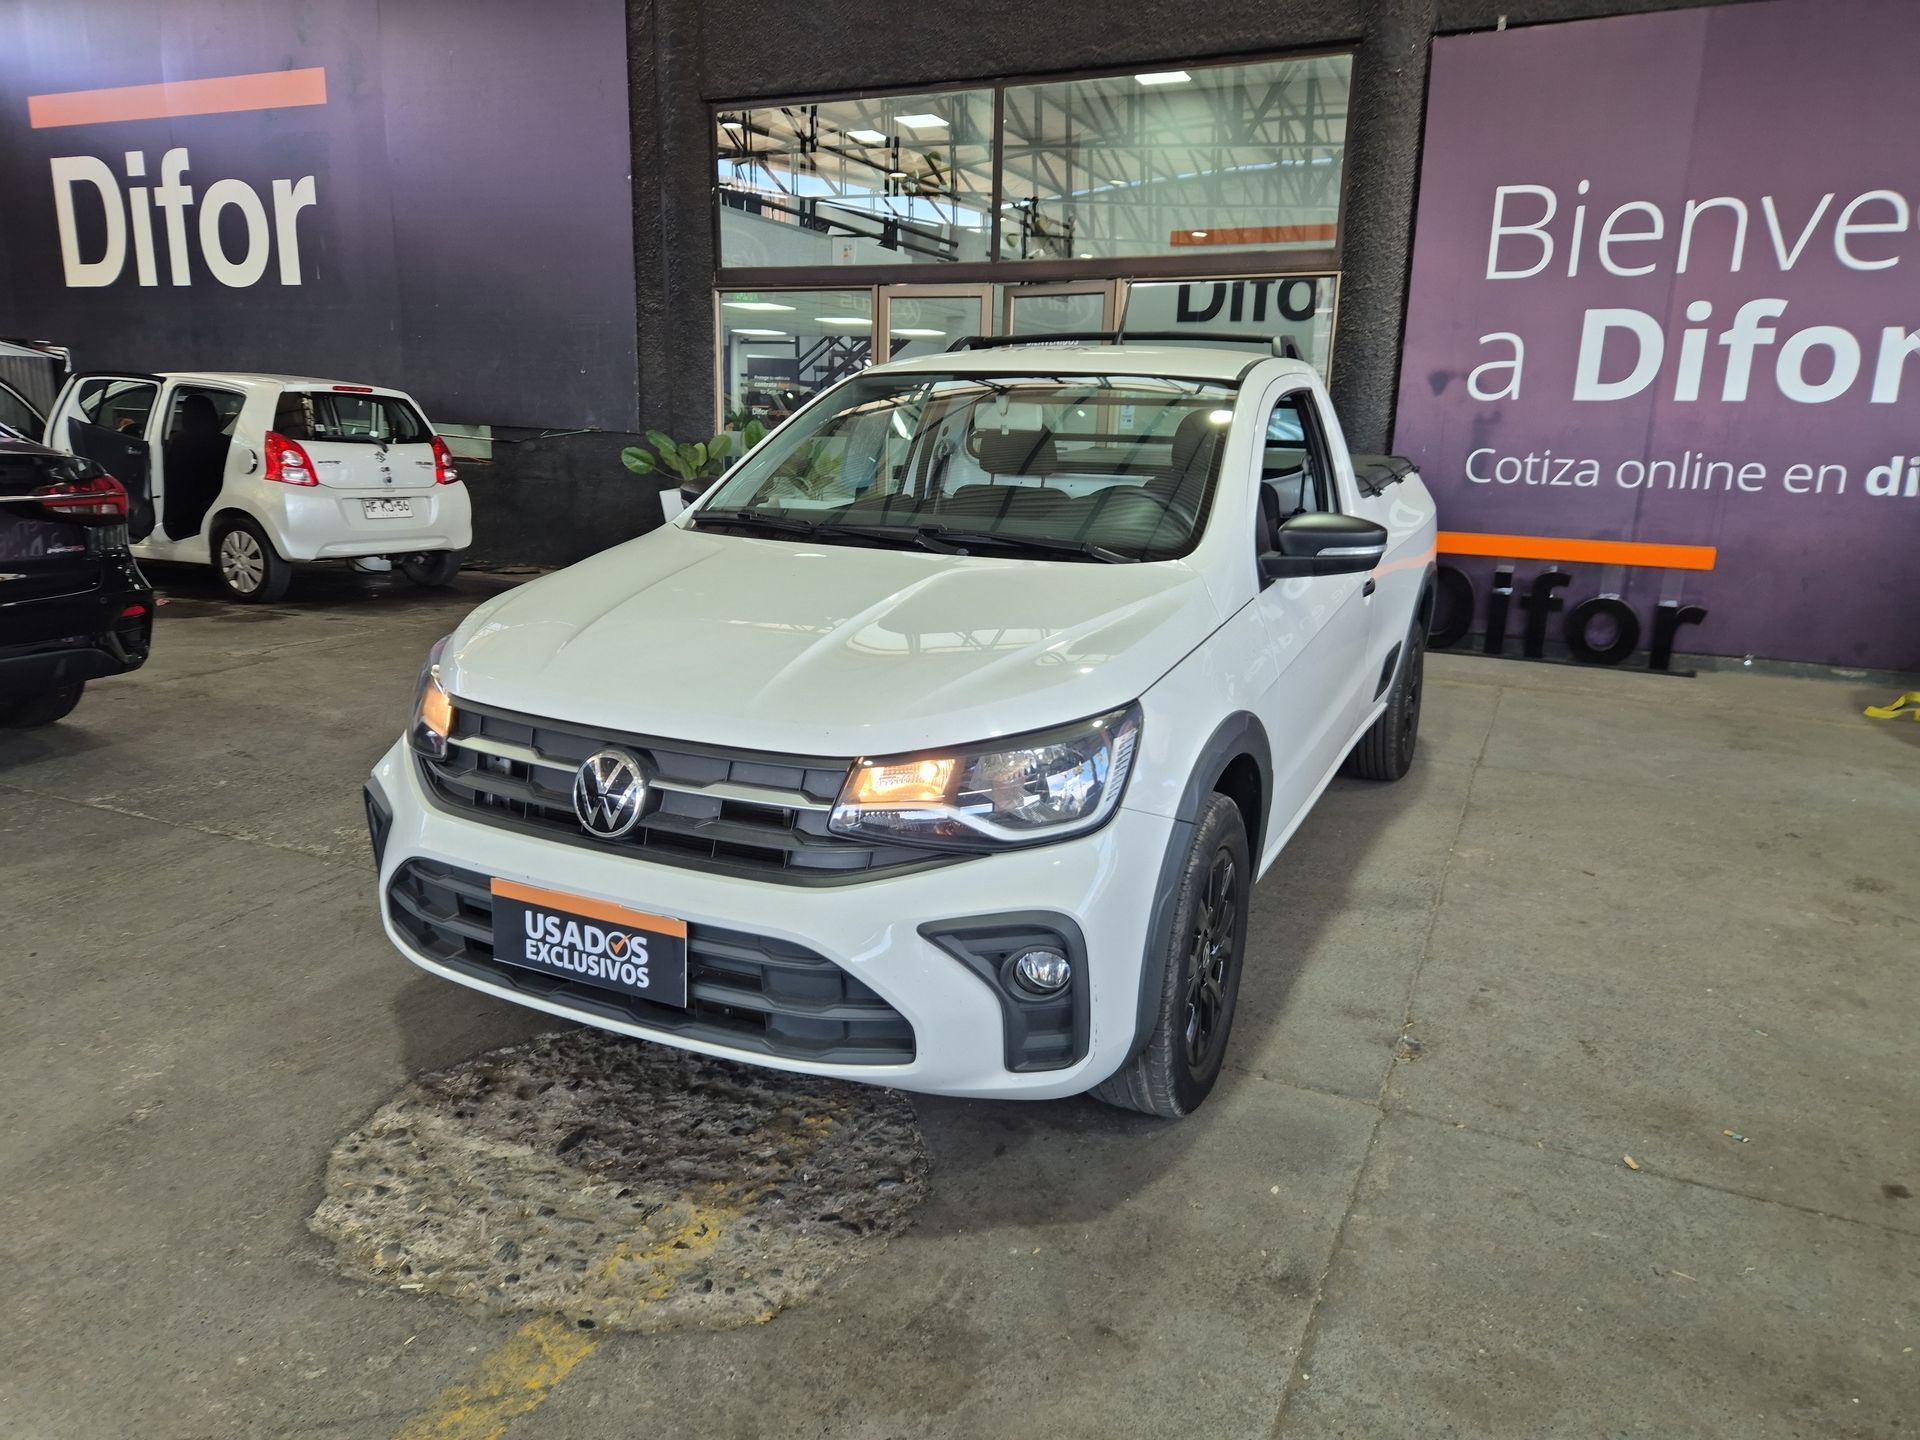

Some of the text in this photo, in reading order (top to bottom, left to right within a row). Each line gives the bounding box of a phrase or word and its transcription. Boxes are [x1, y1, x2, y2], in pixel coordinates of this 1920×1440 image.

[50, 147, 316, 288] Difor
[1485, 179, 1920, 281] Bienve
[1466, 298, 1920, 404] a Difor
[1464, 447, 1600, 489] Cotiza
[1615, 450, 1767, 493] online
[1782, 463, 1847, 495] en
[525, 910, 649, 966] USADOS
[525, 938, 650, 988] EXCLUSIVOS
